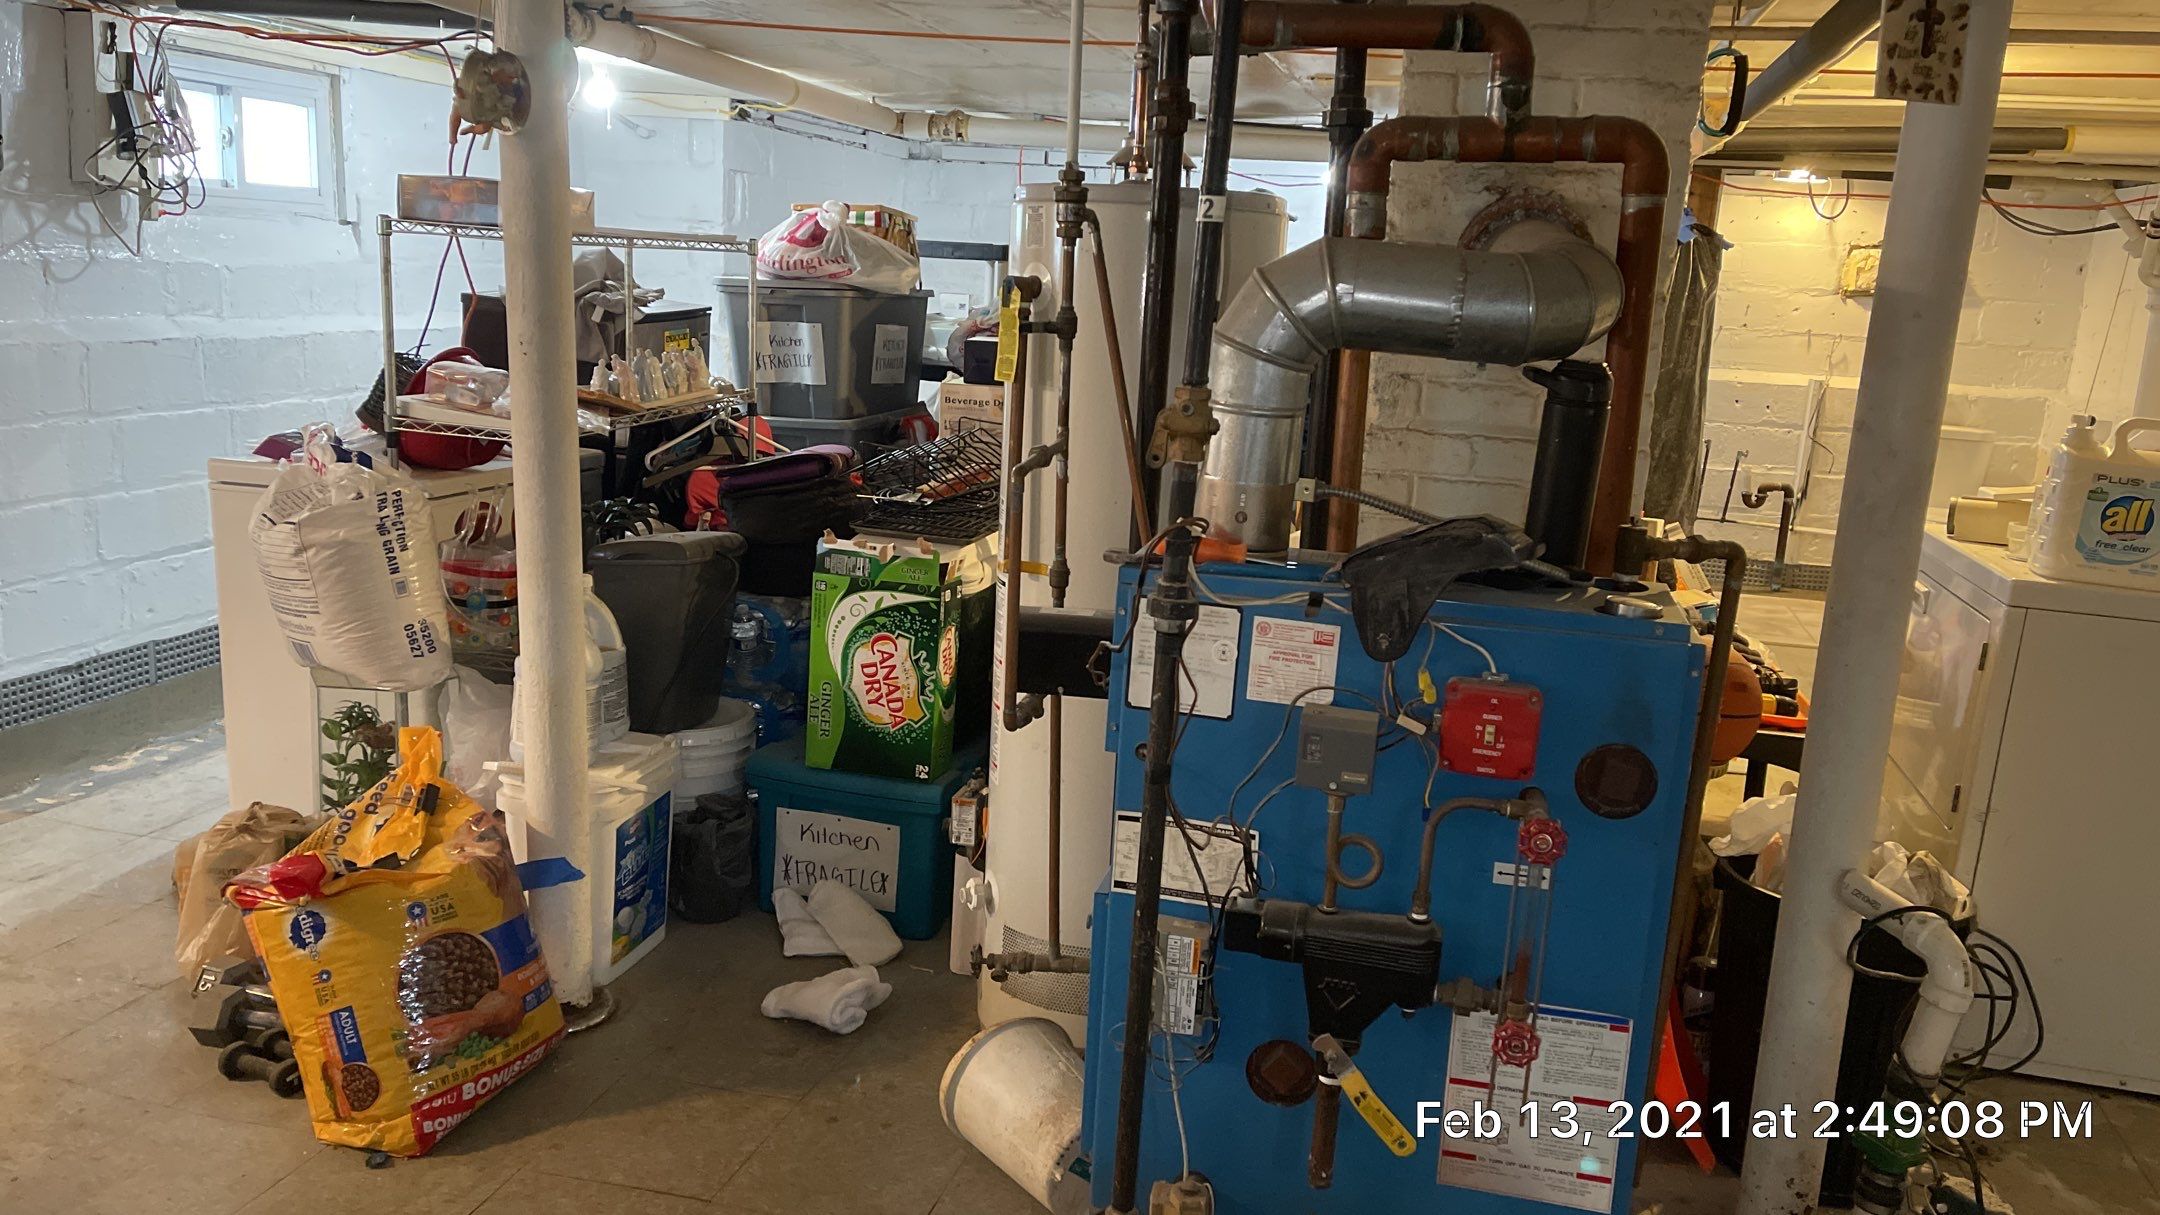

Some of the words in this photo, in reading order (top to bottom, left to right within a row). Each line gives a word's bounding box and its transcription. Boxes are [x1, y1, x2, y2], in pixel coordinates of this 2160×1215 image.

[945, 396, 990, 408] Beverage
[2097, 475, 2142, 487] PLUS
[376, 515, 391, 536] LNG
[2101, 499, 2155, 533] all
[382, 539, 401, 575] GRAIN
[2095, 540, 2118, 550] free
[2123, 544, 2152, 554] clear
[902, 568, 929, 576] GINGER
[403, 623, 425, 658] 05627
[861, 661, 886, 708] DRY
[870, 632, 909, 731] CANADA
[809, 693, 819, 722] ALE
[820, 681, 832, 738] GINGER
[918, 765, 929, 780] 24
[800, 823, 880, 851] Kitchen
[430, 902, 455, 915] USA
[296, 903, 320, 961] edigree
[198, 973, 216, 992] 15
[338, 1011, 357, 1043] ADULT
